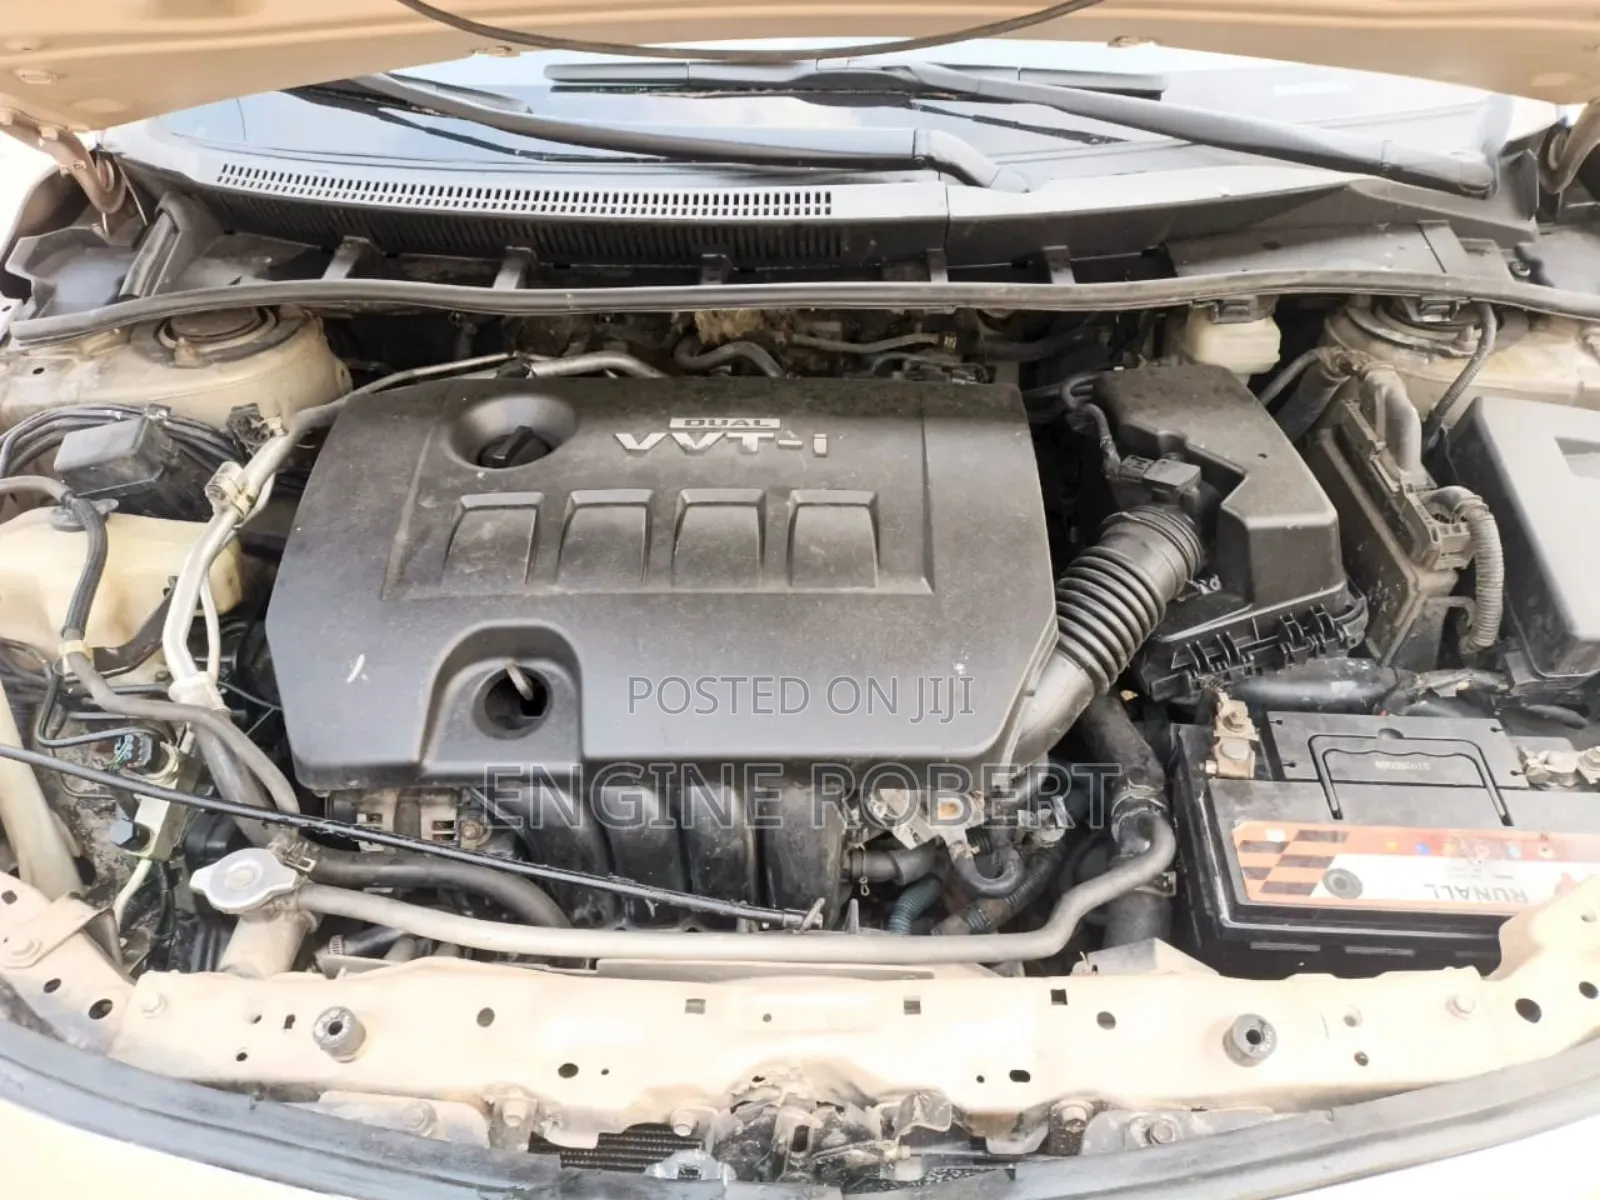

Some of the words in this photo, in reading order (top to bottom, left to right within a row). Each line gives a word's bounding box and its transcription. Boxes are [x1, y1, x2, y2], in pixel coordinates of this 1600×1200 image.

[682, 419, 771, 427] DUAL
[614, 432, 828, 457] VVT-i
[1424, 884, 1528, 903] RUNALL
